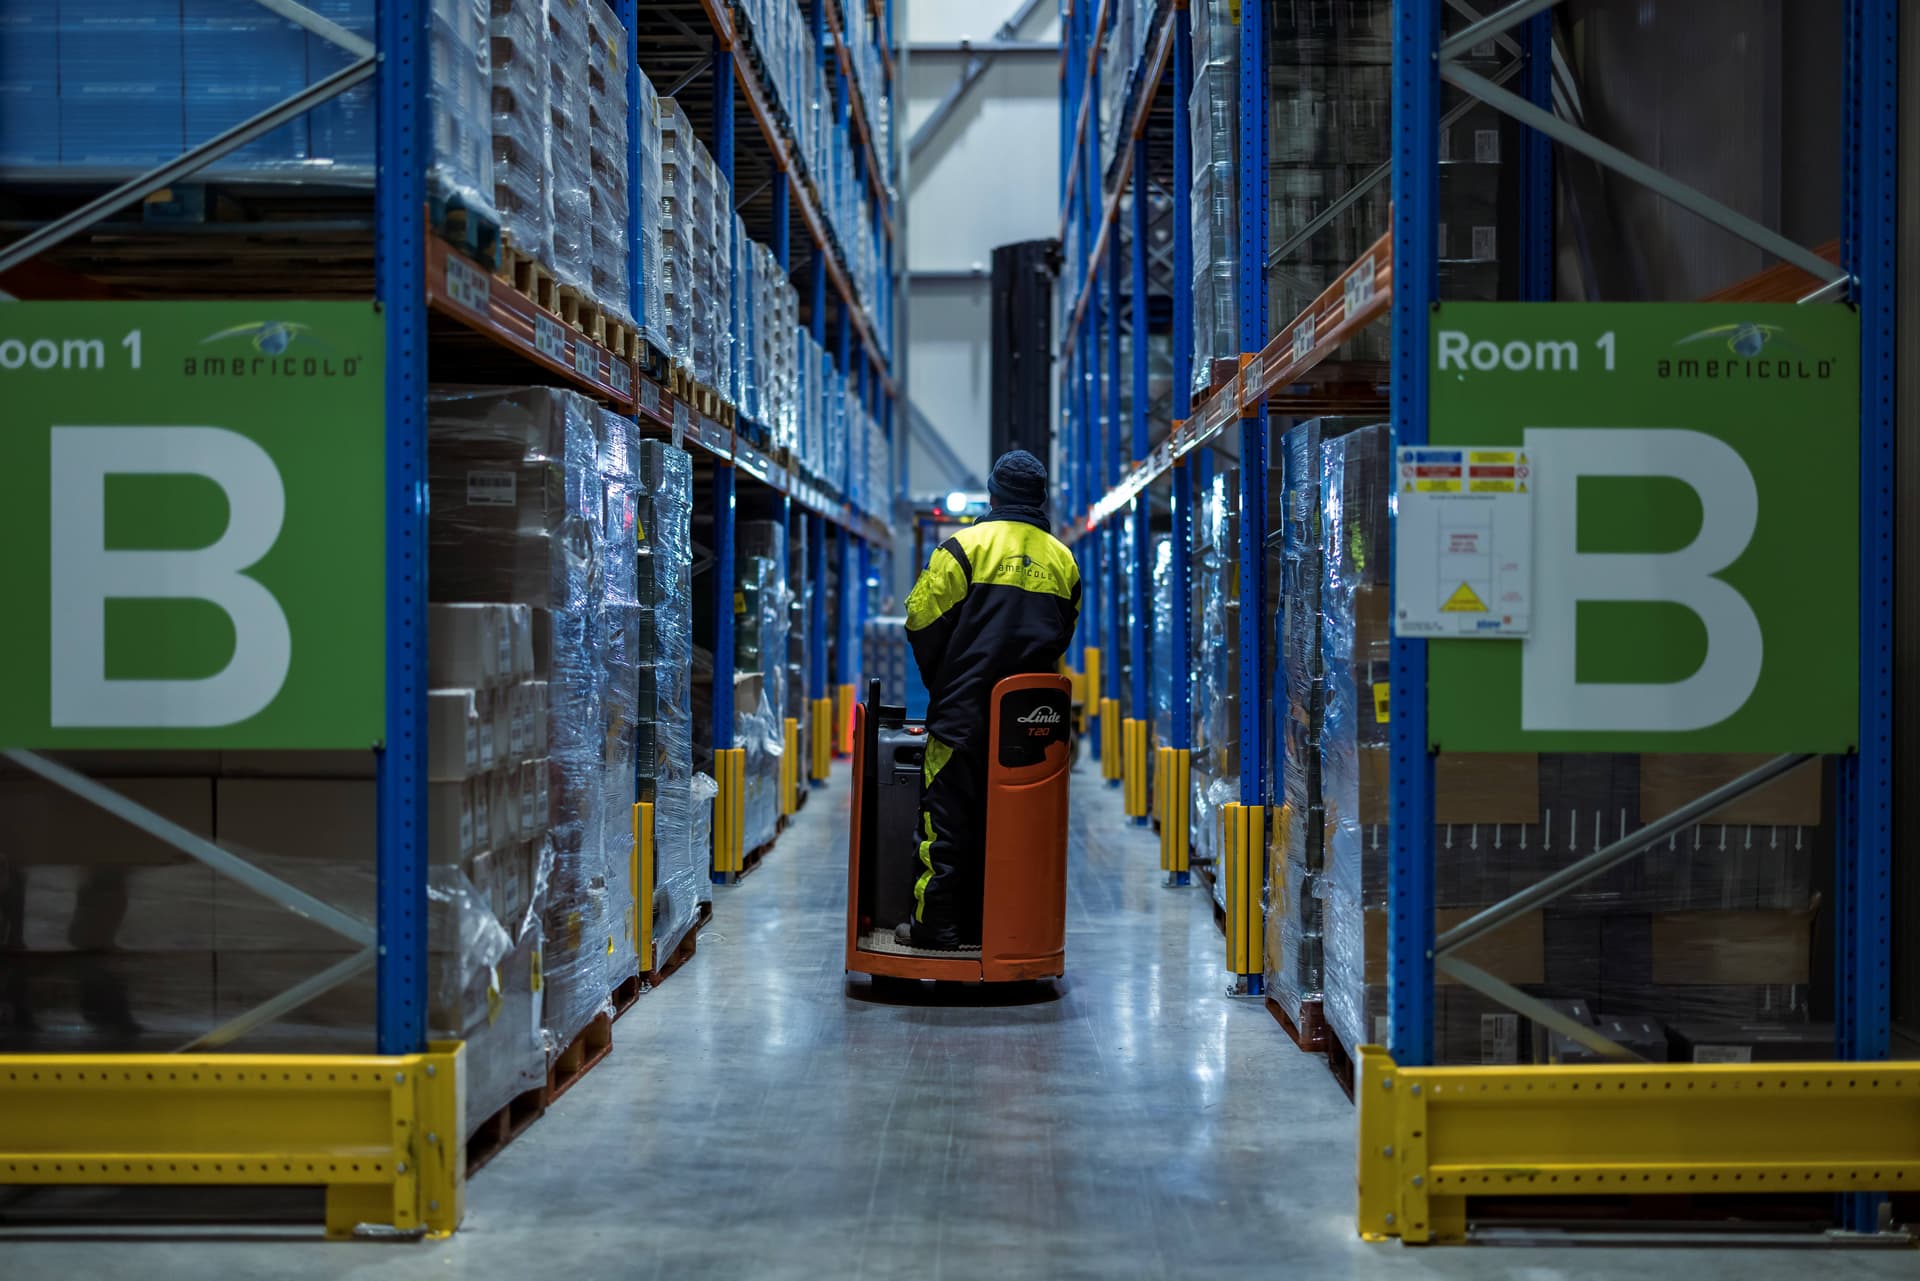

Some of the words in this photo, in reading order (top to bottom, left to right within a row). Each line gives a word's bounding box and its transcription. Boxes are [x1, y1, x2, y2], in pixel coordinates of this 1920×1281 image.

[0, 339, 105, 369] oom
[122, 329, 142, 369] 1
[1437, 330, 1578, 371] Room
[1596, 331, 1615, 371] 1
[50, 425, 292, 728] B
[1521, 428, 1764, 732] B
[1017, 705, 1061, 723] Linde
[1028, 727, 1050, 737] T20
